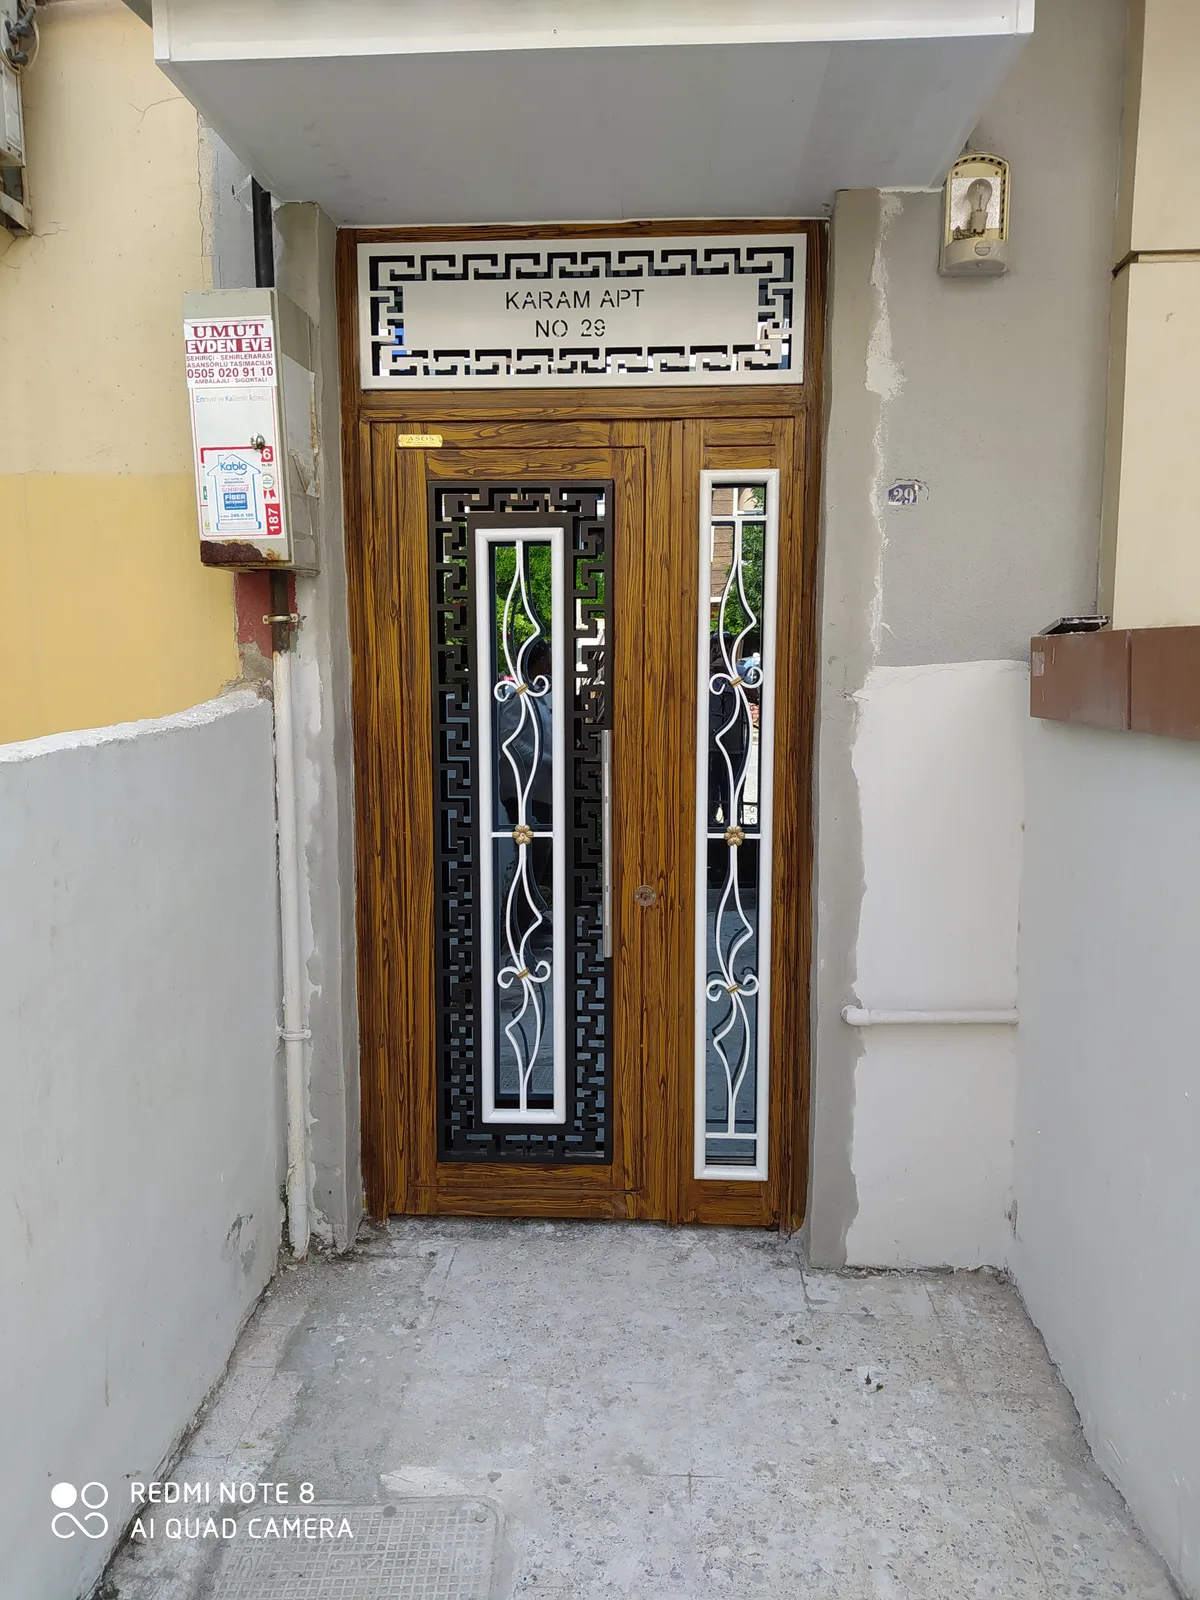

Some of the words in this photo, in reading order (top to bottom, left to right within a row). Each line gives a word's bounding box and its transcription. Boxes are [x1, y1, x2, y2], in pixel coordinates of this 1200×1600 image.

[505, 290, 590, 309] KARAM
[600, 289, 645, 308] APT
[191, 324, 264, 338] UMUT
[536, 319, 568, 338] NO
[580, 318, 606, 338] 29
[187, 339, 237, 353] EVDEN
[241, 338, 271, 352] EVE
[187, 368, 215, 378] 0505
[218, 368, 239, 377] 020
[242, 367, 256, 377] 91
[260, 367, 274, 376] 10
[262, 448, 271, 460] 6
[220, 462, 247, 471] Kablo
[893, 487, 914, 505] 29
[268, 508, 280, 532] 187
